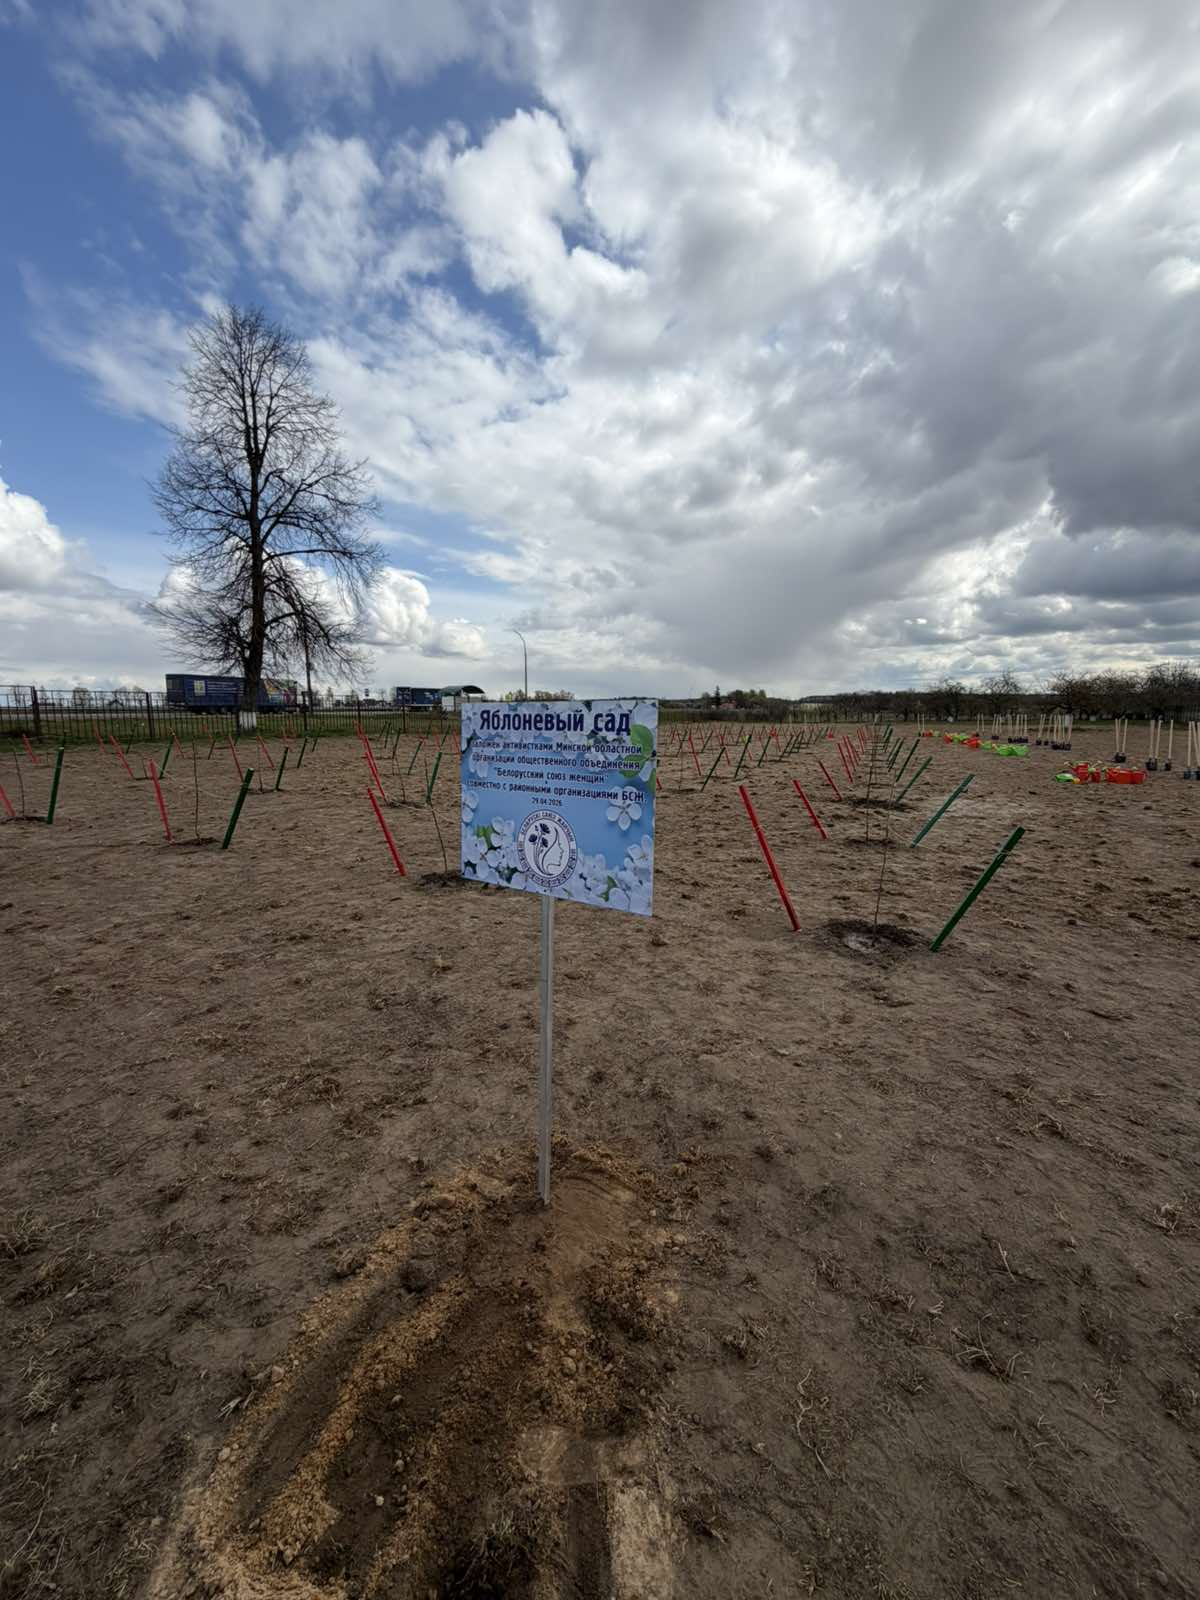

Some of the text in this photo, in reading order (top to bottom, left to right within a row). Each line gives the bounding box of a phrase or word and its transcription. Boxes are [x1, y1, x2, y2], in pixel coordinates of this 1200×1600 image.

[479, 709, 632, 736] Яблоневый сад
[556, 742, 592, 752] Минской
[594, 743, 642, 754] областной
[517, 756, 577, 767] общественного
[580, 759, 640, 770] объединения
[509, 782, 551, 793] районными
[553, 787, 619, 799] организациями
